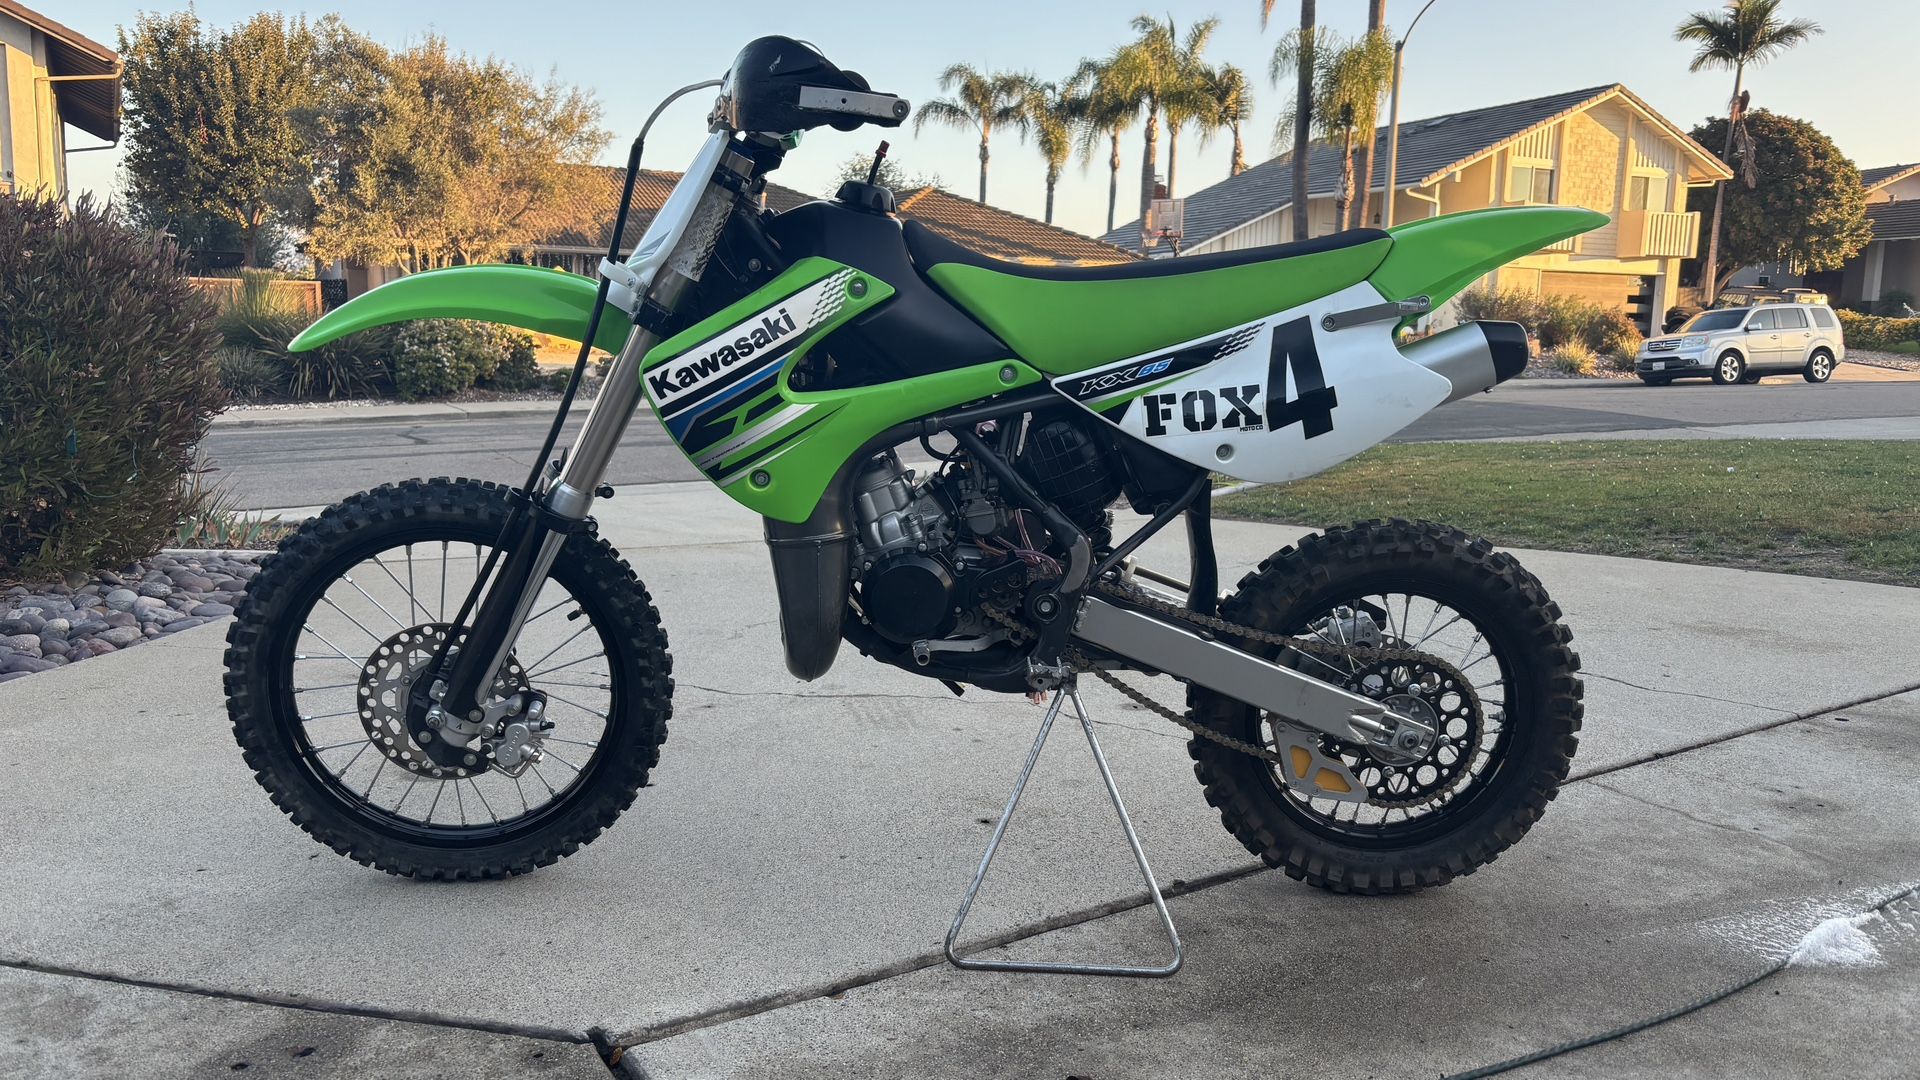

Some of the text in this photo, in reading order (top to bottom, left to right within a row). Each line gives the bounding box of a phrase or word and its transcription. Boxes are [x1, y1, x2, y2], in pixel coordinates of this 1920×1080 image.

[648, 307, 797, 400] Kawasaki
[1266, 315, 1338, 440] 4
[1143, 384, 1263, 437] FOX
